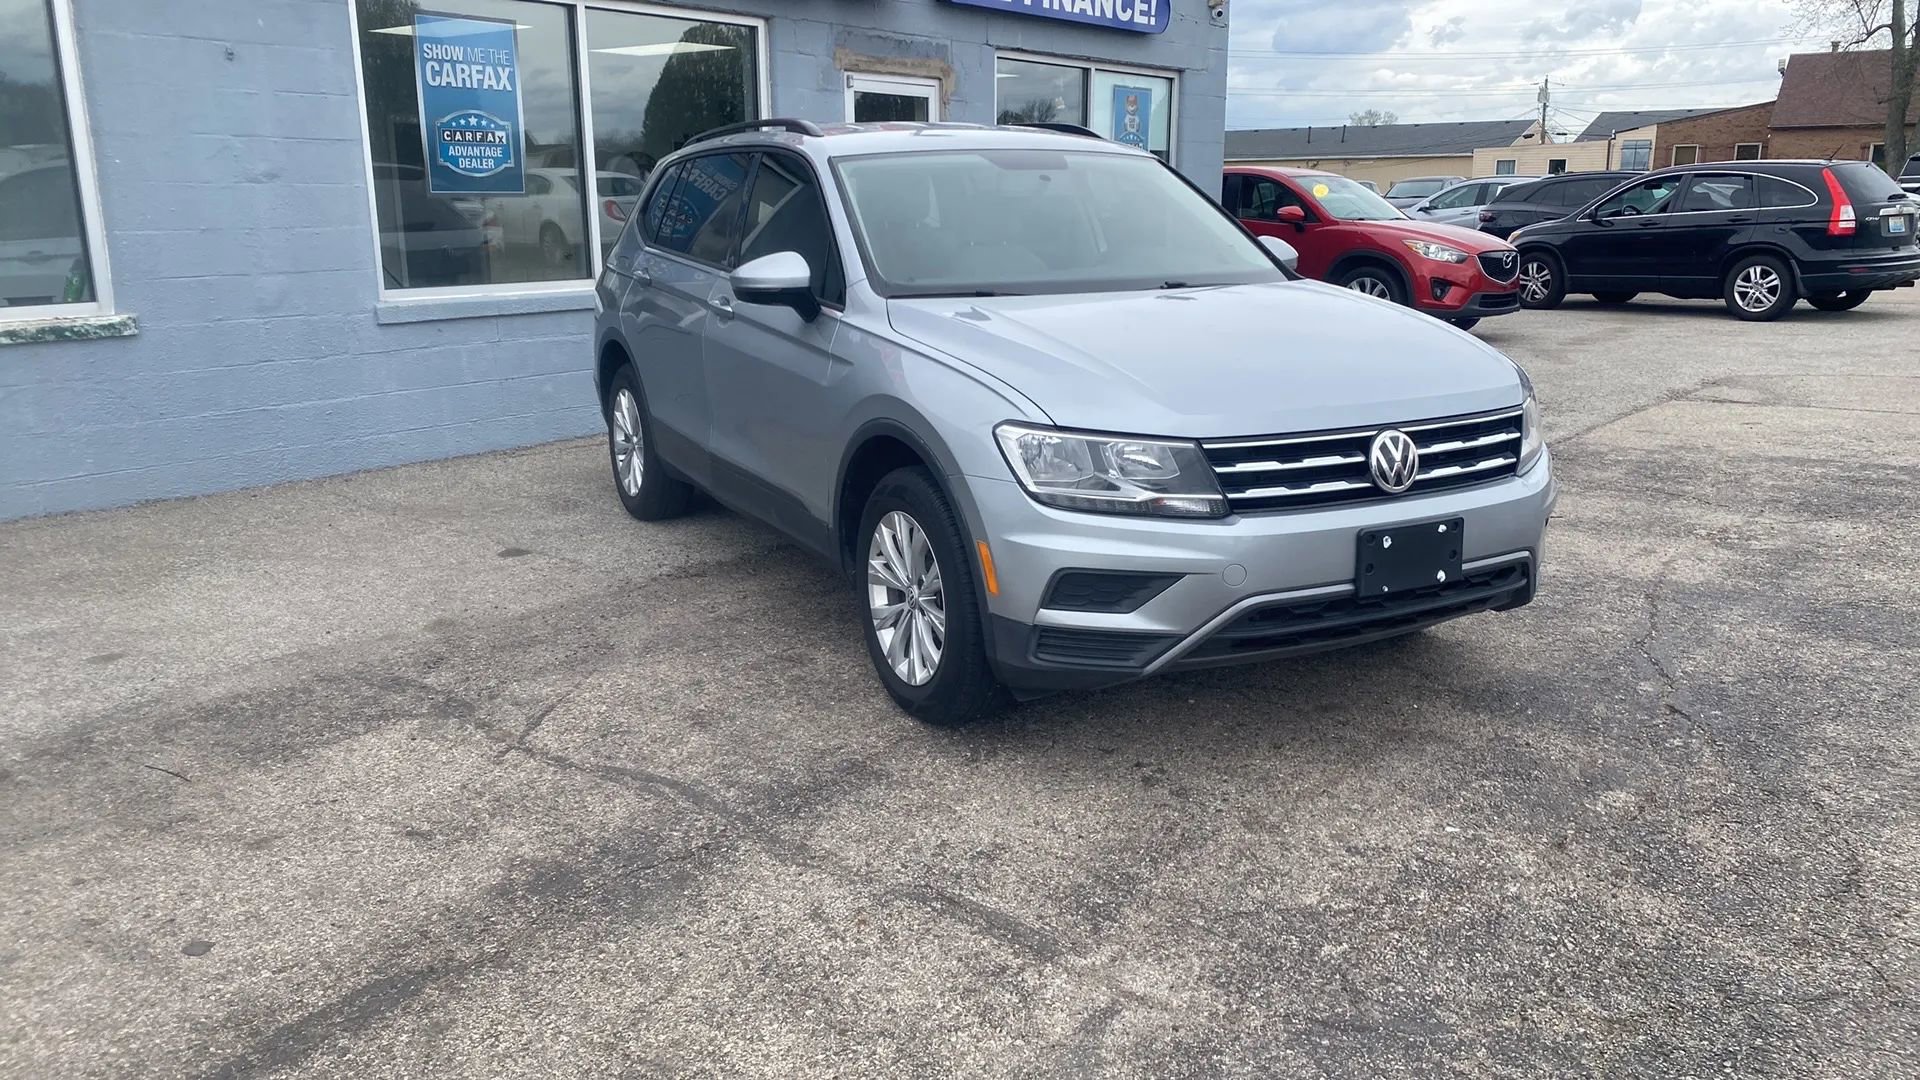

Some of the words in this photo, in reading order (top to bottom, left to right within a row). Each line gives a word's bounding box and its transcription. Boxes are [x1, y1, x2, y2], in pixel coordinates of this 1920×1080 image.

[1023, 0, 1156, 25] ANCE!
[423, 43, 464, 61] SHOW
[467, 47, 486, 64] ME
[488, 49, 511, 66] THE
[425, 60, 513, 91] CARFAX
[443, 130, 506, 144] CARFAX
[448, 145, 503, 158] ADVANTAGE
[458, 157, 495, 169] DEALER
